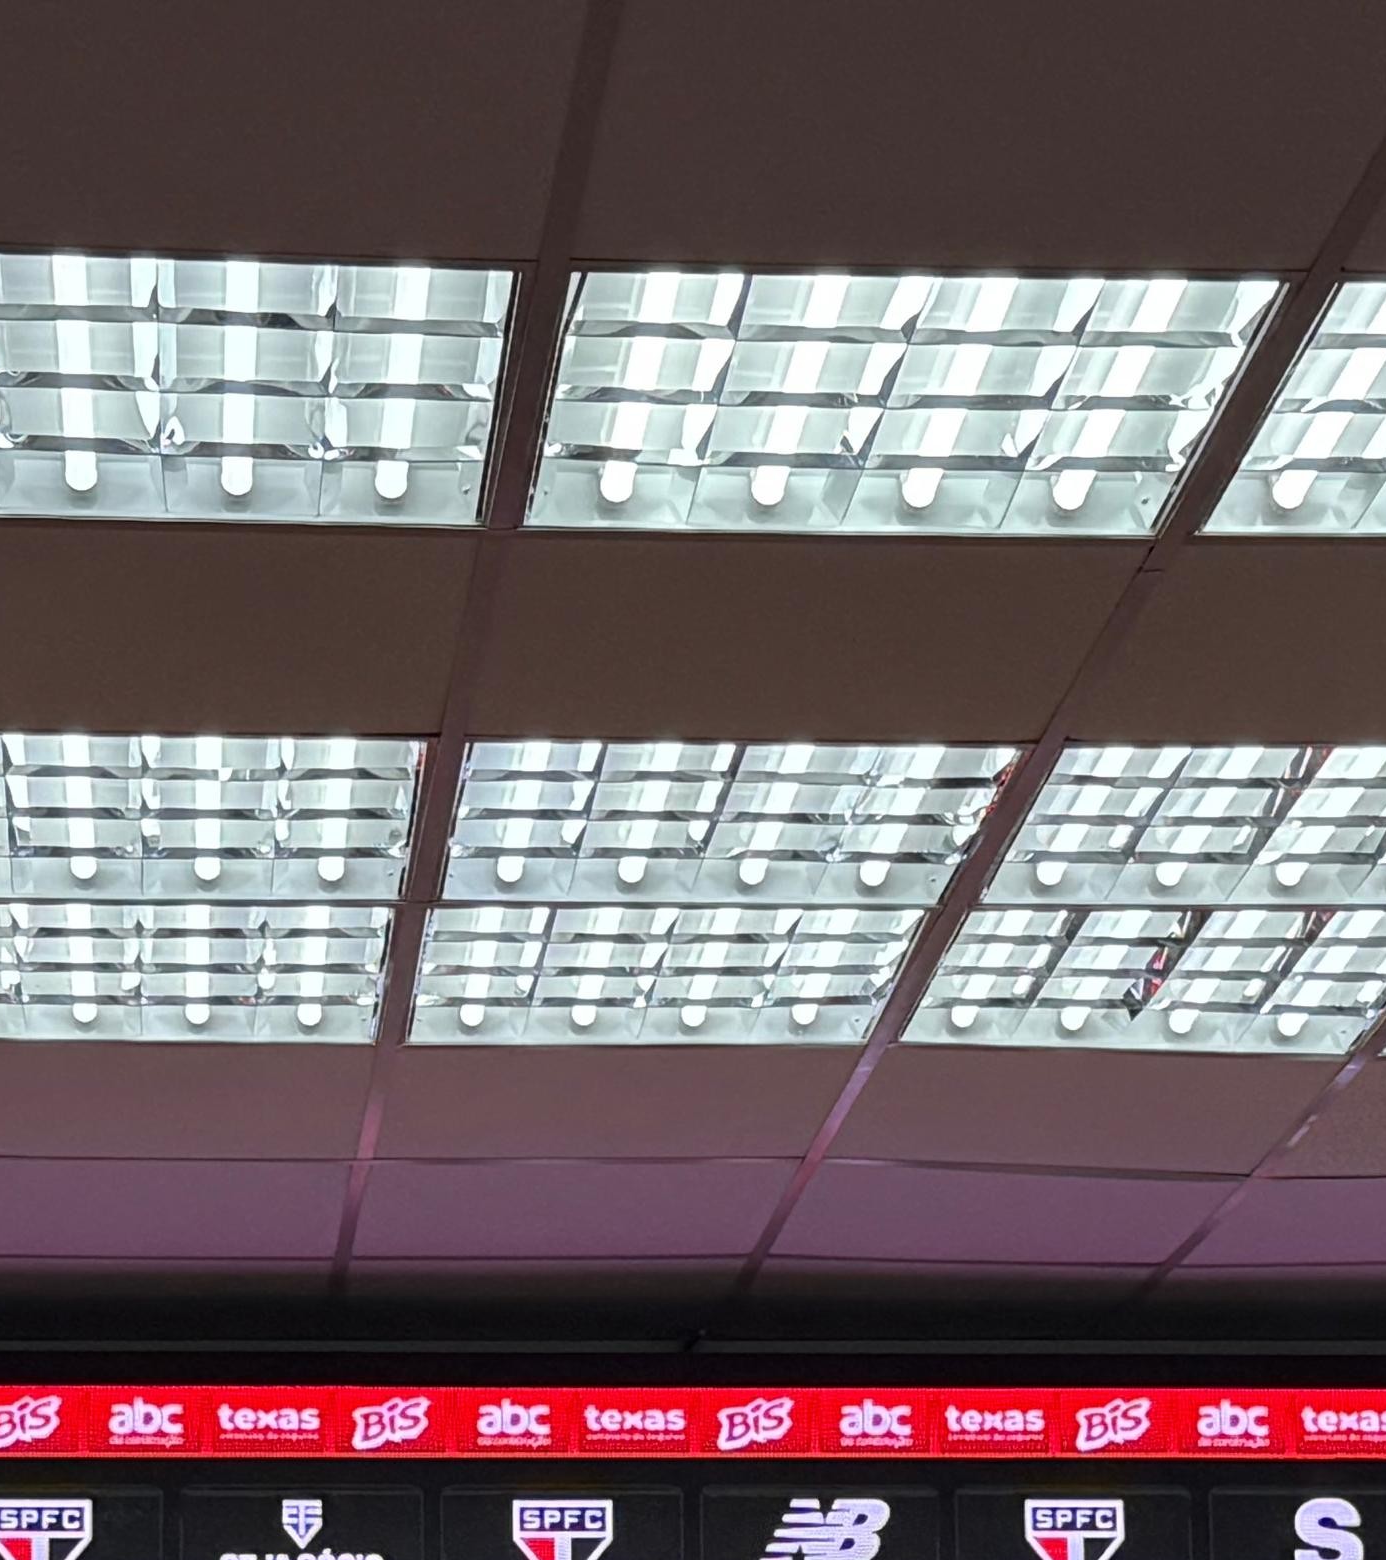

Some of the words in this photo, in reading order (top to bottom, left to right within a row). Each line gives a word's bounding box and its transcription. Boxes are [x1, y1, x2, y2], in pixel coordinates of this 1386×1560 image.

[109, 1396, 184, 1435] abc
[217, 1403, 320, 1430] texas
[477, 1398, 550, 1436] abc
[584, 1404, 686, 1431] texas
[840, 1399, 911, 1437] abc
[945, 1404, 1044, 1432] texas
[1197, 1399, 1269, 1436] abc
[0, 1508, 84, 1530] SPFC
[523, 1509, 603, 1530] SPFC
[1035, 1508, 1115, 1529] SPFC
